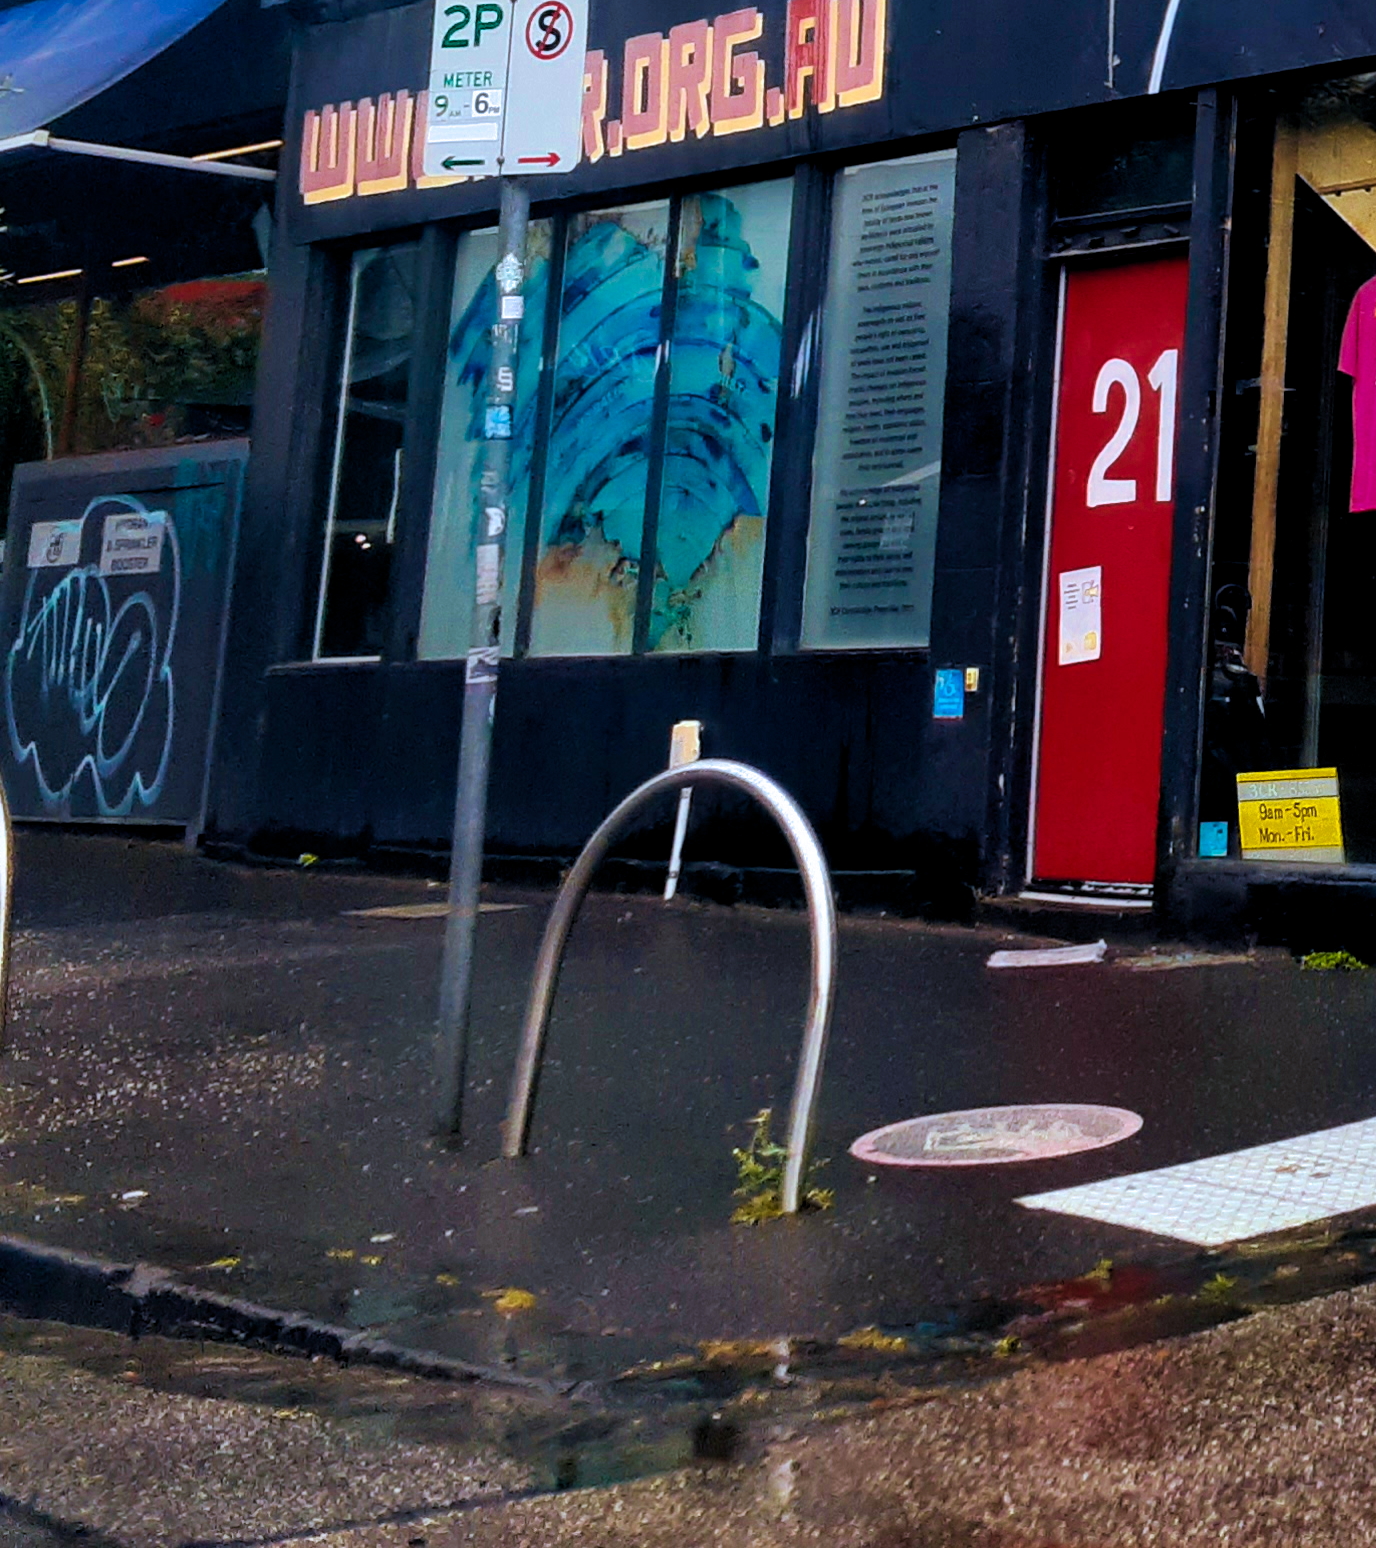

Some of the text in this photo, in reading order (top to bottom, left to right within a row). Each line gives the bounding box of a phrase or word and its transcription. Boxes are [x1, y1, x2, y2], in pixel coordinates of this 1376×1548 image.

[441, 3, 503, 48] 2P
[443, 71, 493, 88] METER
[1087, 349, 1178, 507] 21
